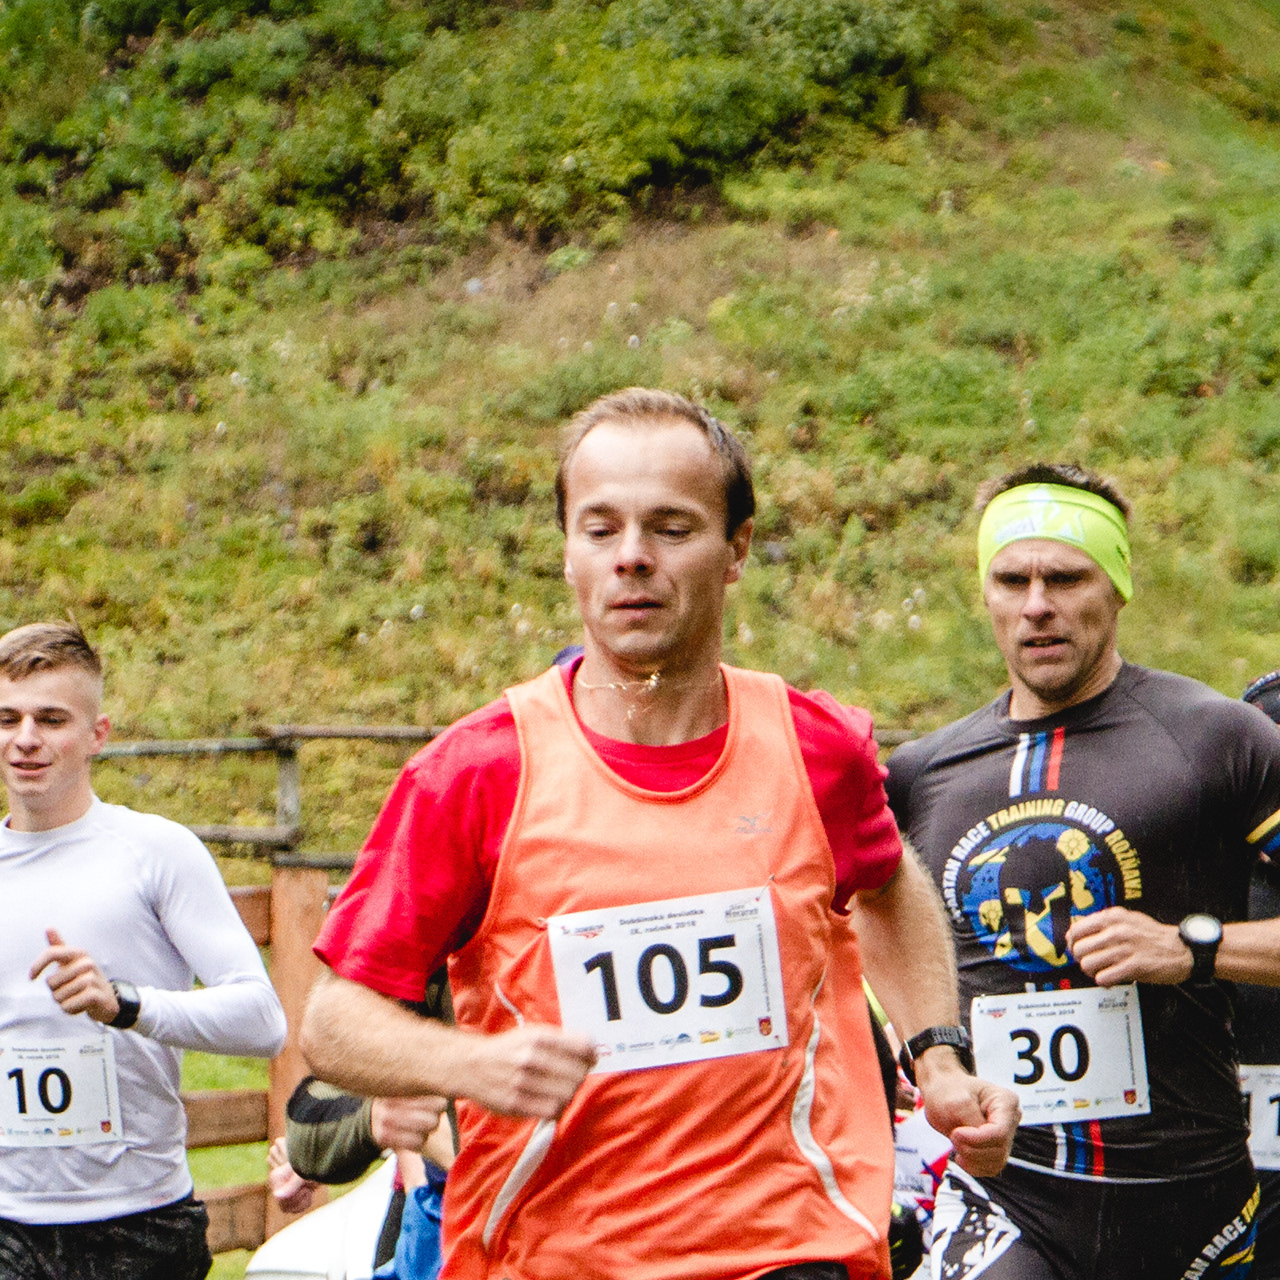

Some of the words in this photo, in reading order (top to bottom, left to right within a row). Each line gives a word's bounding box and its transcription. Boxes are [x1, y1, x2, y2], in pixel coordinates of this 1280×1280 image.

[951, 820, 991, 861] RACE
[986, 798, 1066, 831] TRAINING
[1063, 800, 1116, 835] GROUP
[583, 933, 744, 1022] 105
[1009, 1023, 1091, 1086] 30
[7, 1067, 73, 1115] 10
[1201, 1215, 1248, 1261] RACE
